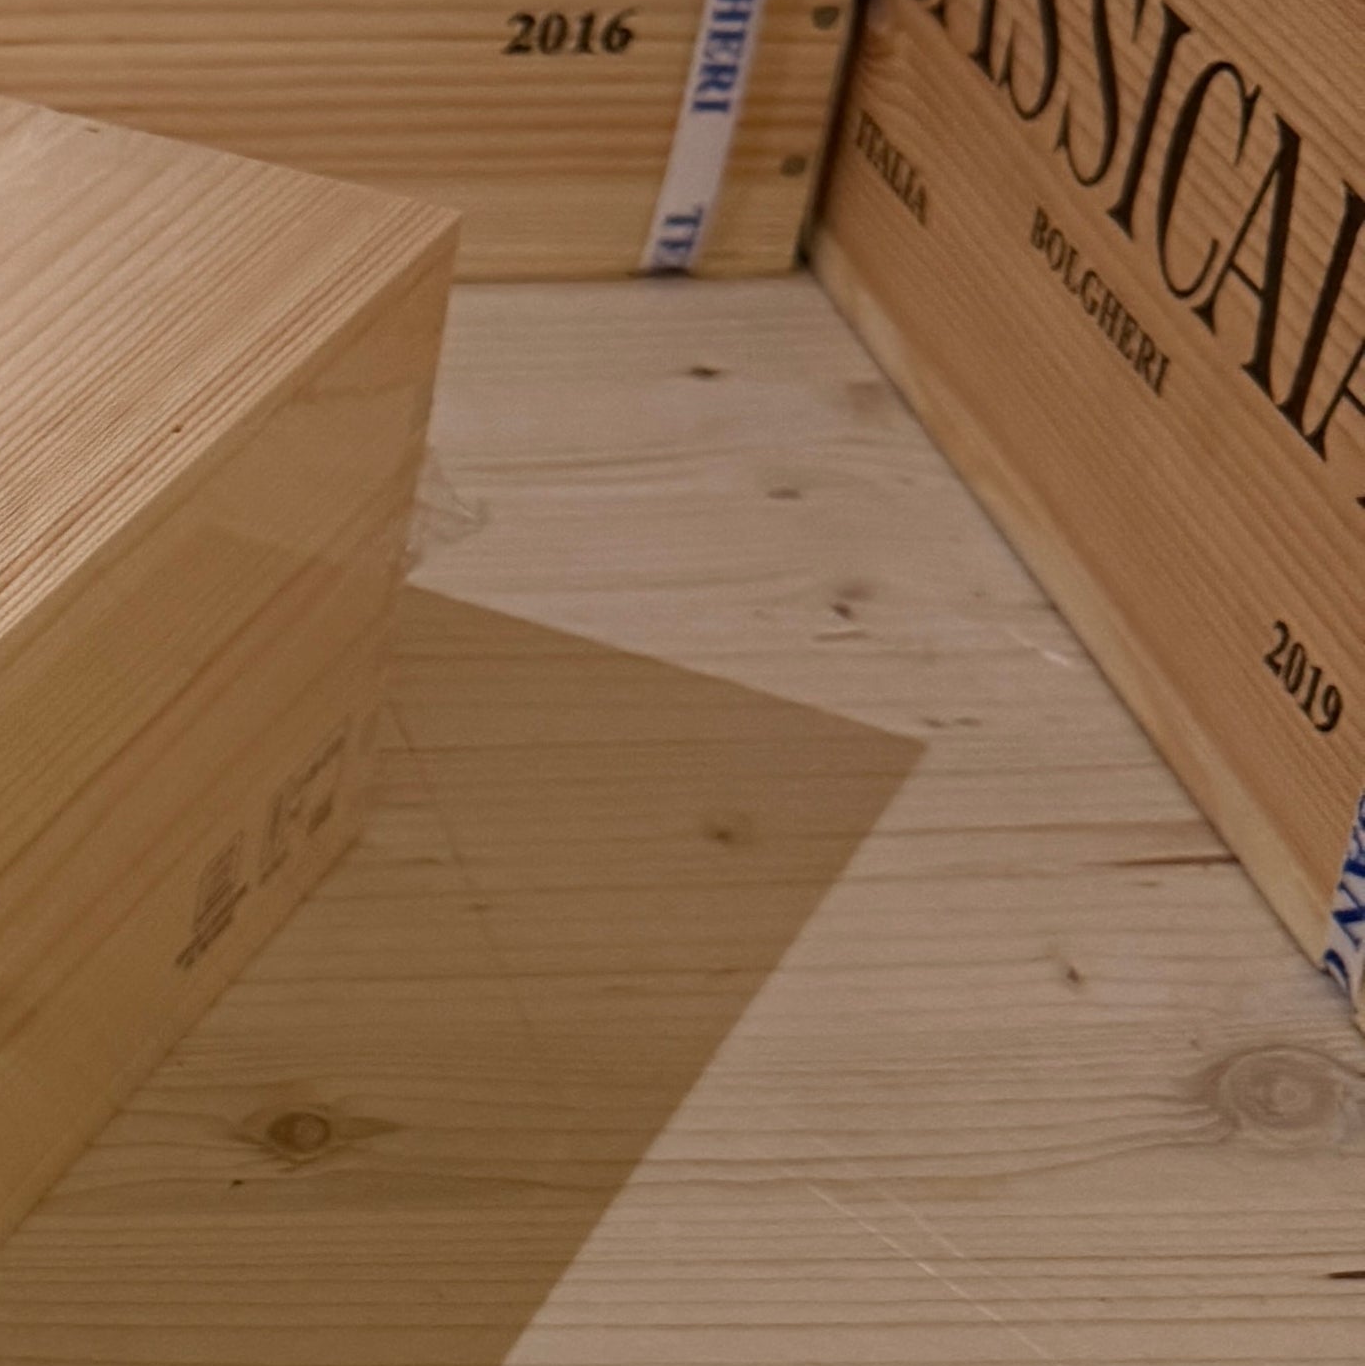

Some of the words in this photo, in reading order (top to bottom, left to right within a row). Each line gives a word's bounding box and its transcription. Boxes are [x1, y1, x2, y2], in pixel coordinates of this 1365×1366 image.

[501, 8, 639, 58] 2016
[1030, 205, 1170, 399] BOLGHERI
[1263, 619, 1345, 733] 2019
